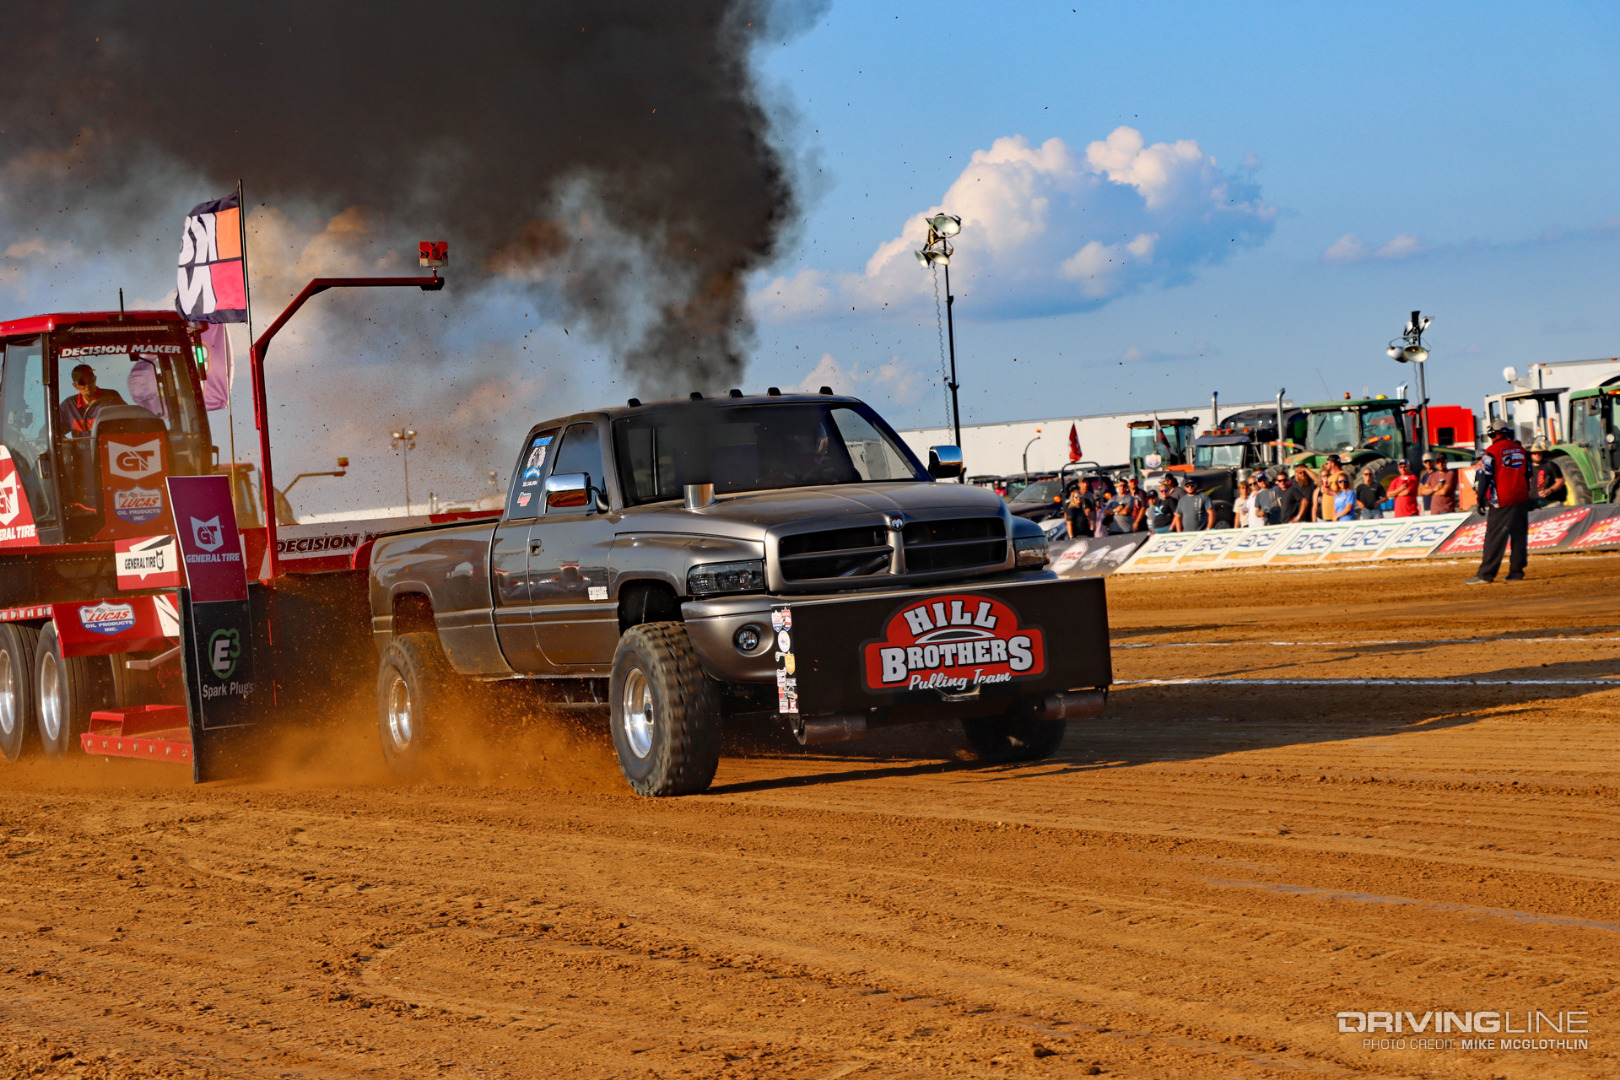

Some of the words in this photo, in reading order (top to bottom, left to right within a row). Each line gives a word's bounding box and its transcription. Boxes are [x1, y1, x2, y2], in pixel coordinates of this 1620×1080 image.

[62, 345, 128, 357] DECISION
[131, 344, 181, 354] MAKER
[120, 496, 159, 508] LUCAS
[16, 524, 36, 538] TIRE
[277, 534, 359, 553] DECISION
[125, 558, 145, 569] GENERAL
[146, 556, 156, 568] TIRE
[186, 553, 221, 563] GENERAL
[222, 552, 240, 562] TIRE
[88, 610, 130, 622] LUCAS
[903, 600, 998, 636] HILL
[98, 619, 133, 627] PRODUCTS
[880, 635, 1033, 683] BROTHERS
[908, 672, 968, 690] Pulling
[973, 668, 1011, 685] Team
[202, 683, 228, 700] Spark
[230, 681, 254, 697] Plugs
